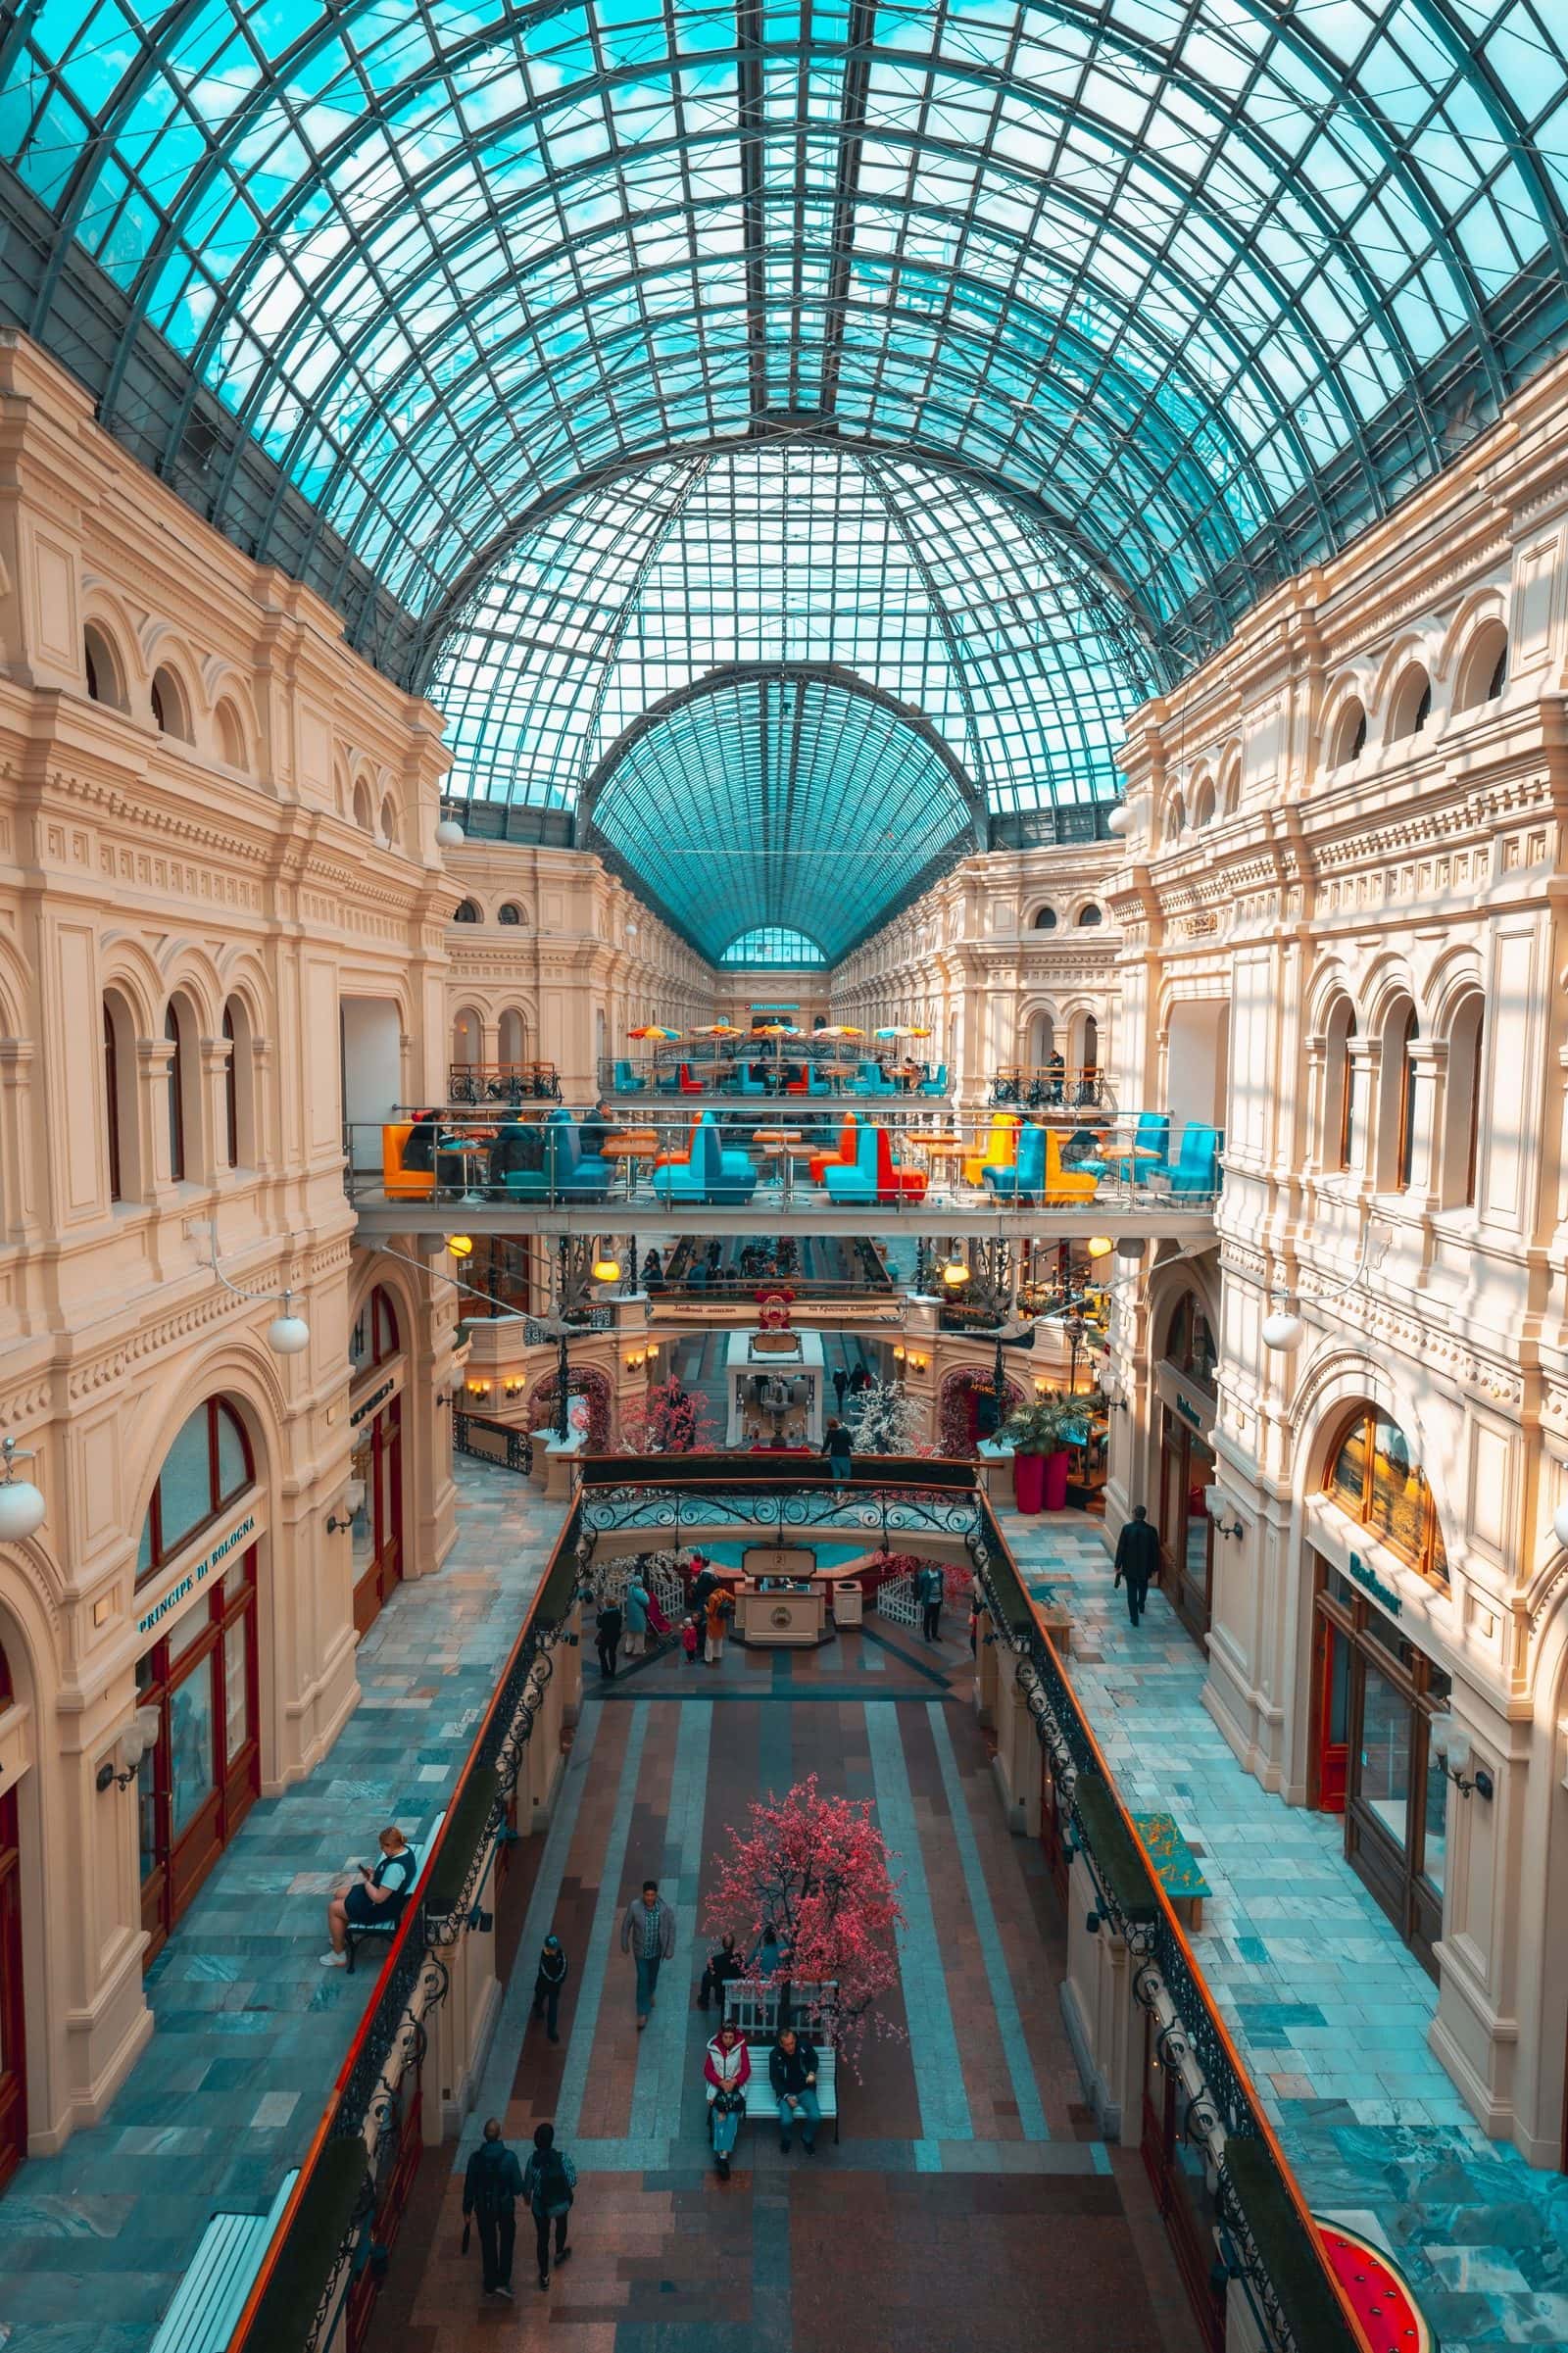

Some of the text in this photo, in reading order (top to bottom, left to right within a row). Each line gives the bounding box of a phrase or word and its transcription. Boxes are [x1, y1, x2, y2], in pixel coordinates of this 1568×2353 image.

[137, 1515, 255, 1634] PRINCIPE DI BOLOGNA
